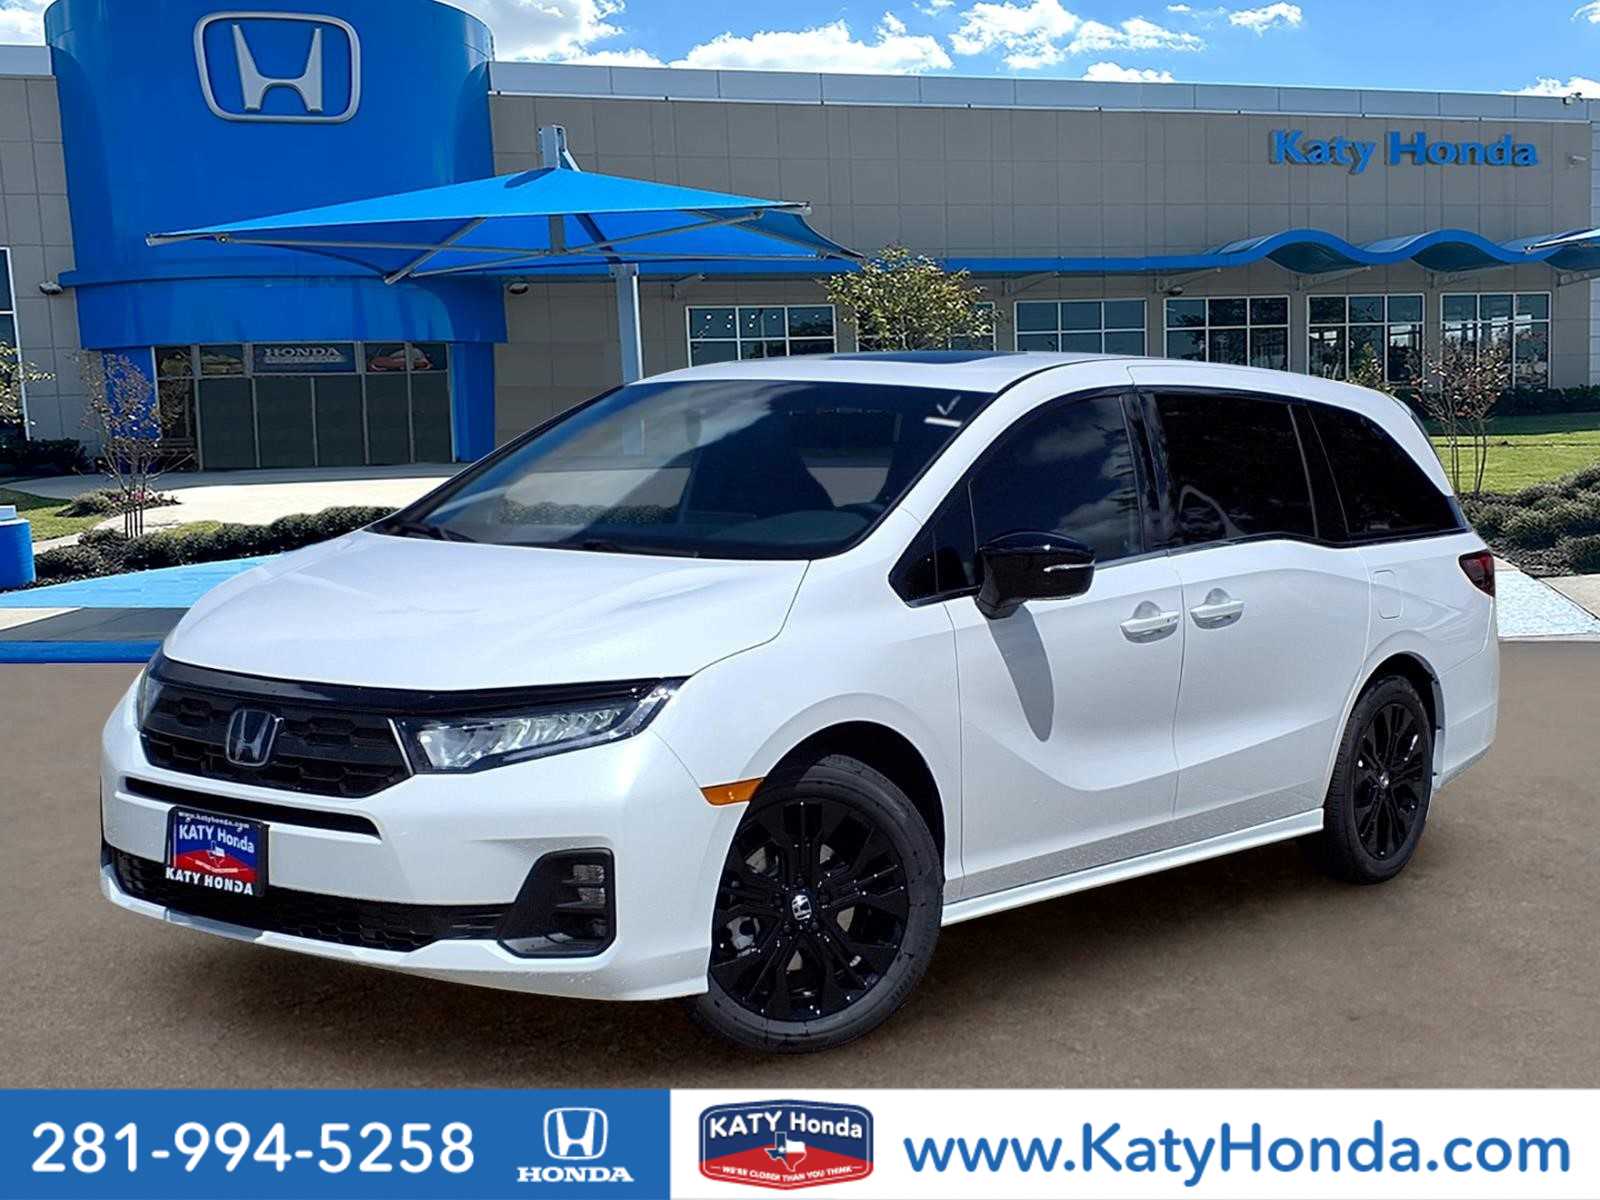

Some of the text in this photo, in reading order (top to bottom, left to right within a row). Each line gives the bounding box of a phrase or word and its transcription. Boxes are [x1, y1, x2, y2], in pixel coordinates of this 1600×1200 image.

[1270, 129, 1539, 174] Katy Honda
[264, 347, 341, 357] HONDA
[179, 824, 255, 853] KATY Honda
[165, 866, 201, 885] KATY
[203, 873, 254, 896] HONDA
